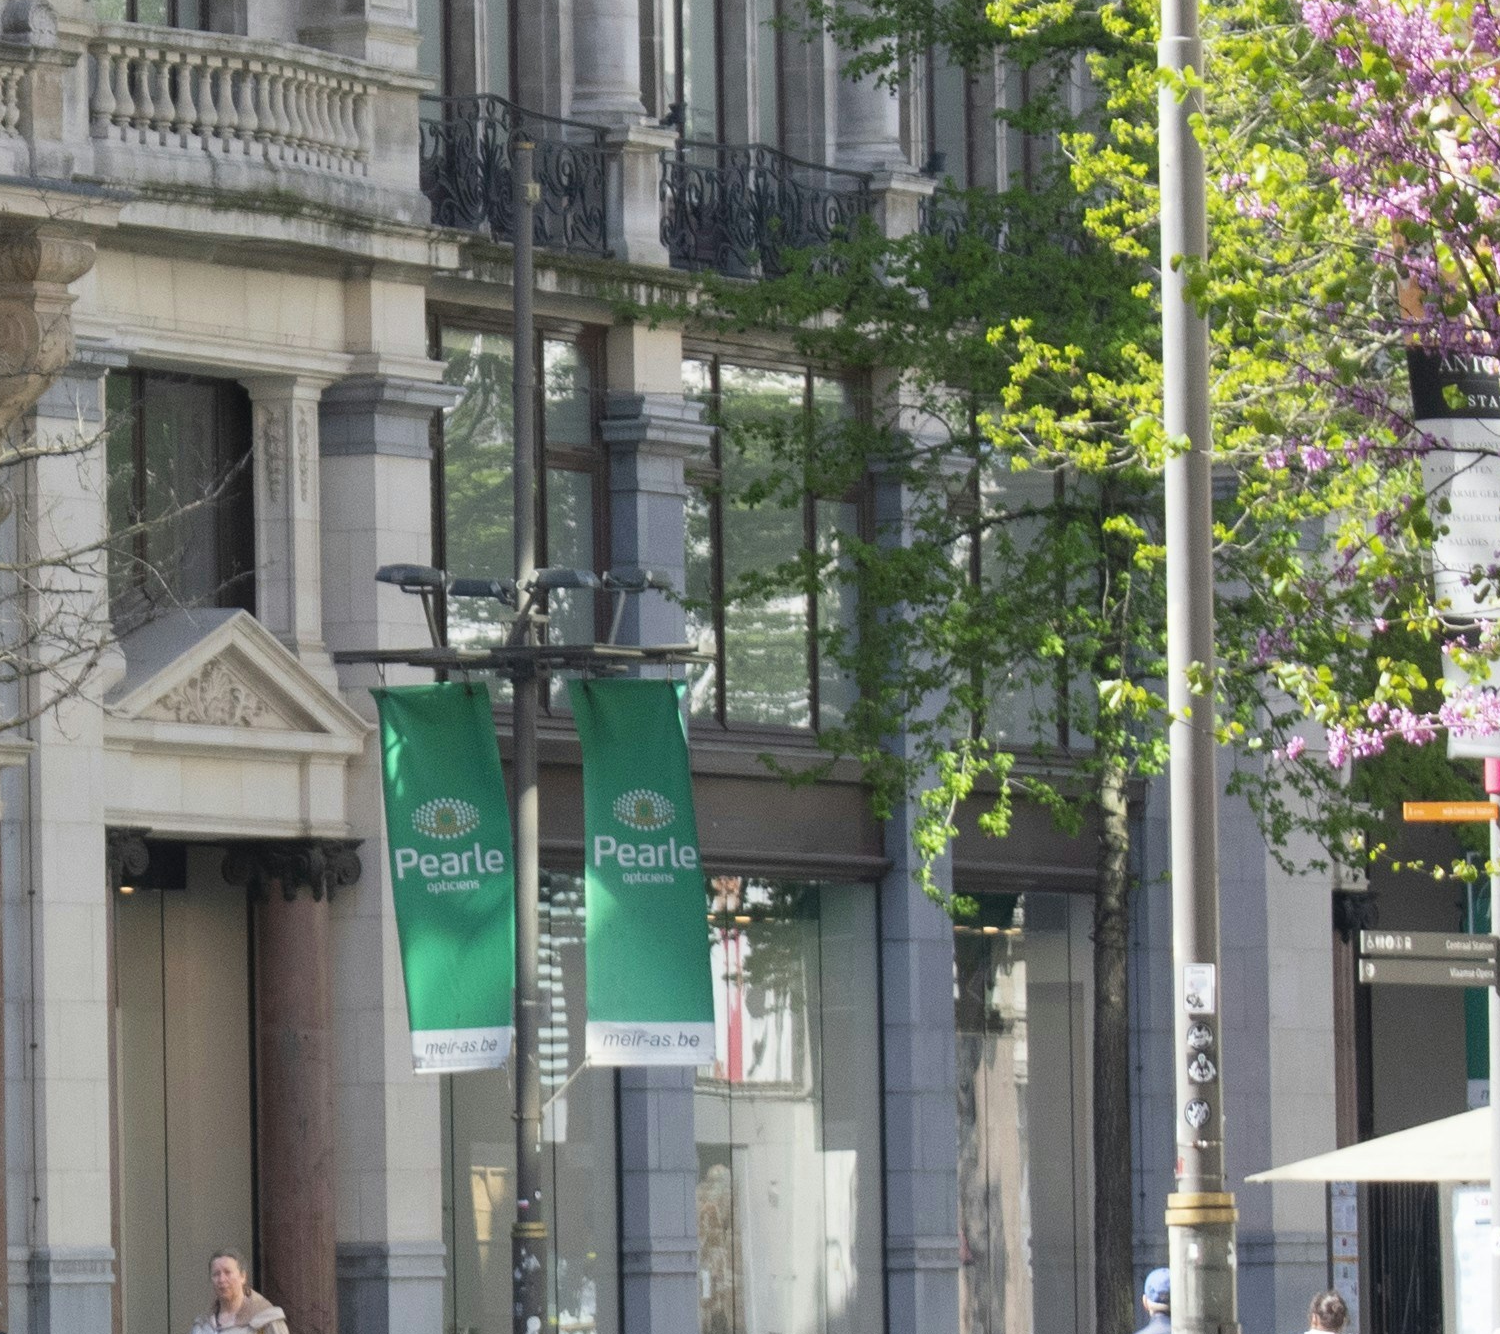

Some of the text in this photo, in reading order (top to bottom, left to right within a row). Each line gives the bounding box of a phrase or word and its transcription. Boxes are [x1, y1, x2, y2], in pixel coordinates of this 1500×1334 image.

[394, 842, 505, 880] Pearle
[593, 834, 698, 870] Pearle
[426, 878, 481, 894] opticiens
[621, 870, 675, 884] opticiens
[424, 1036, 498, 1056] meir-as.be
[602, 1029, 701, 1049] meir-as.be
